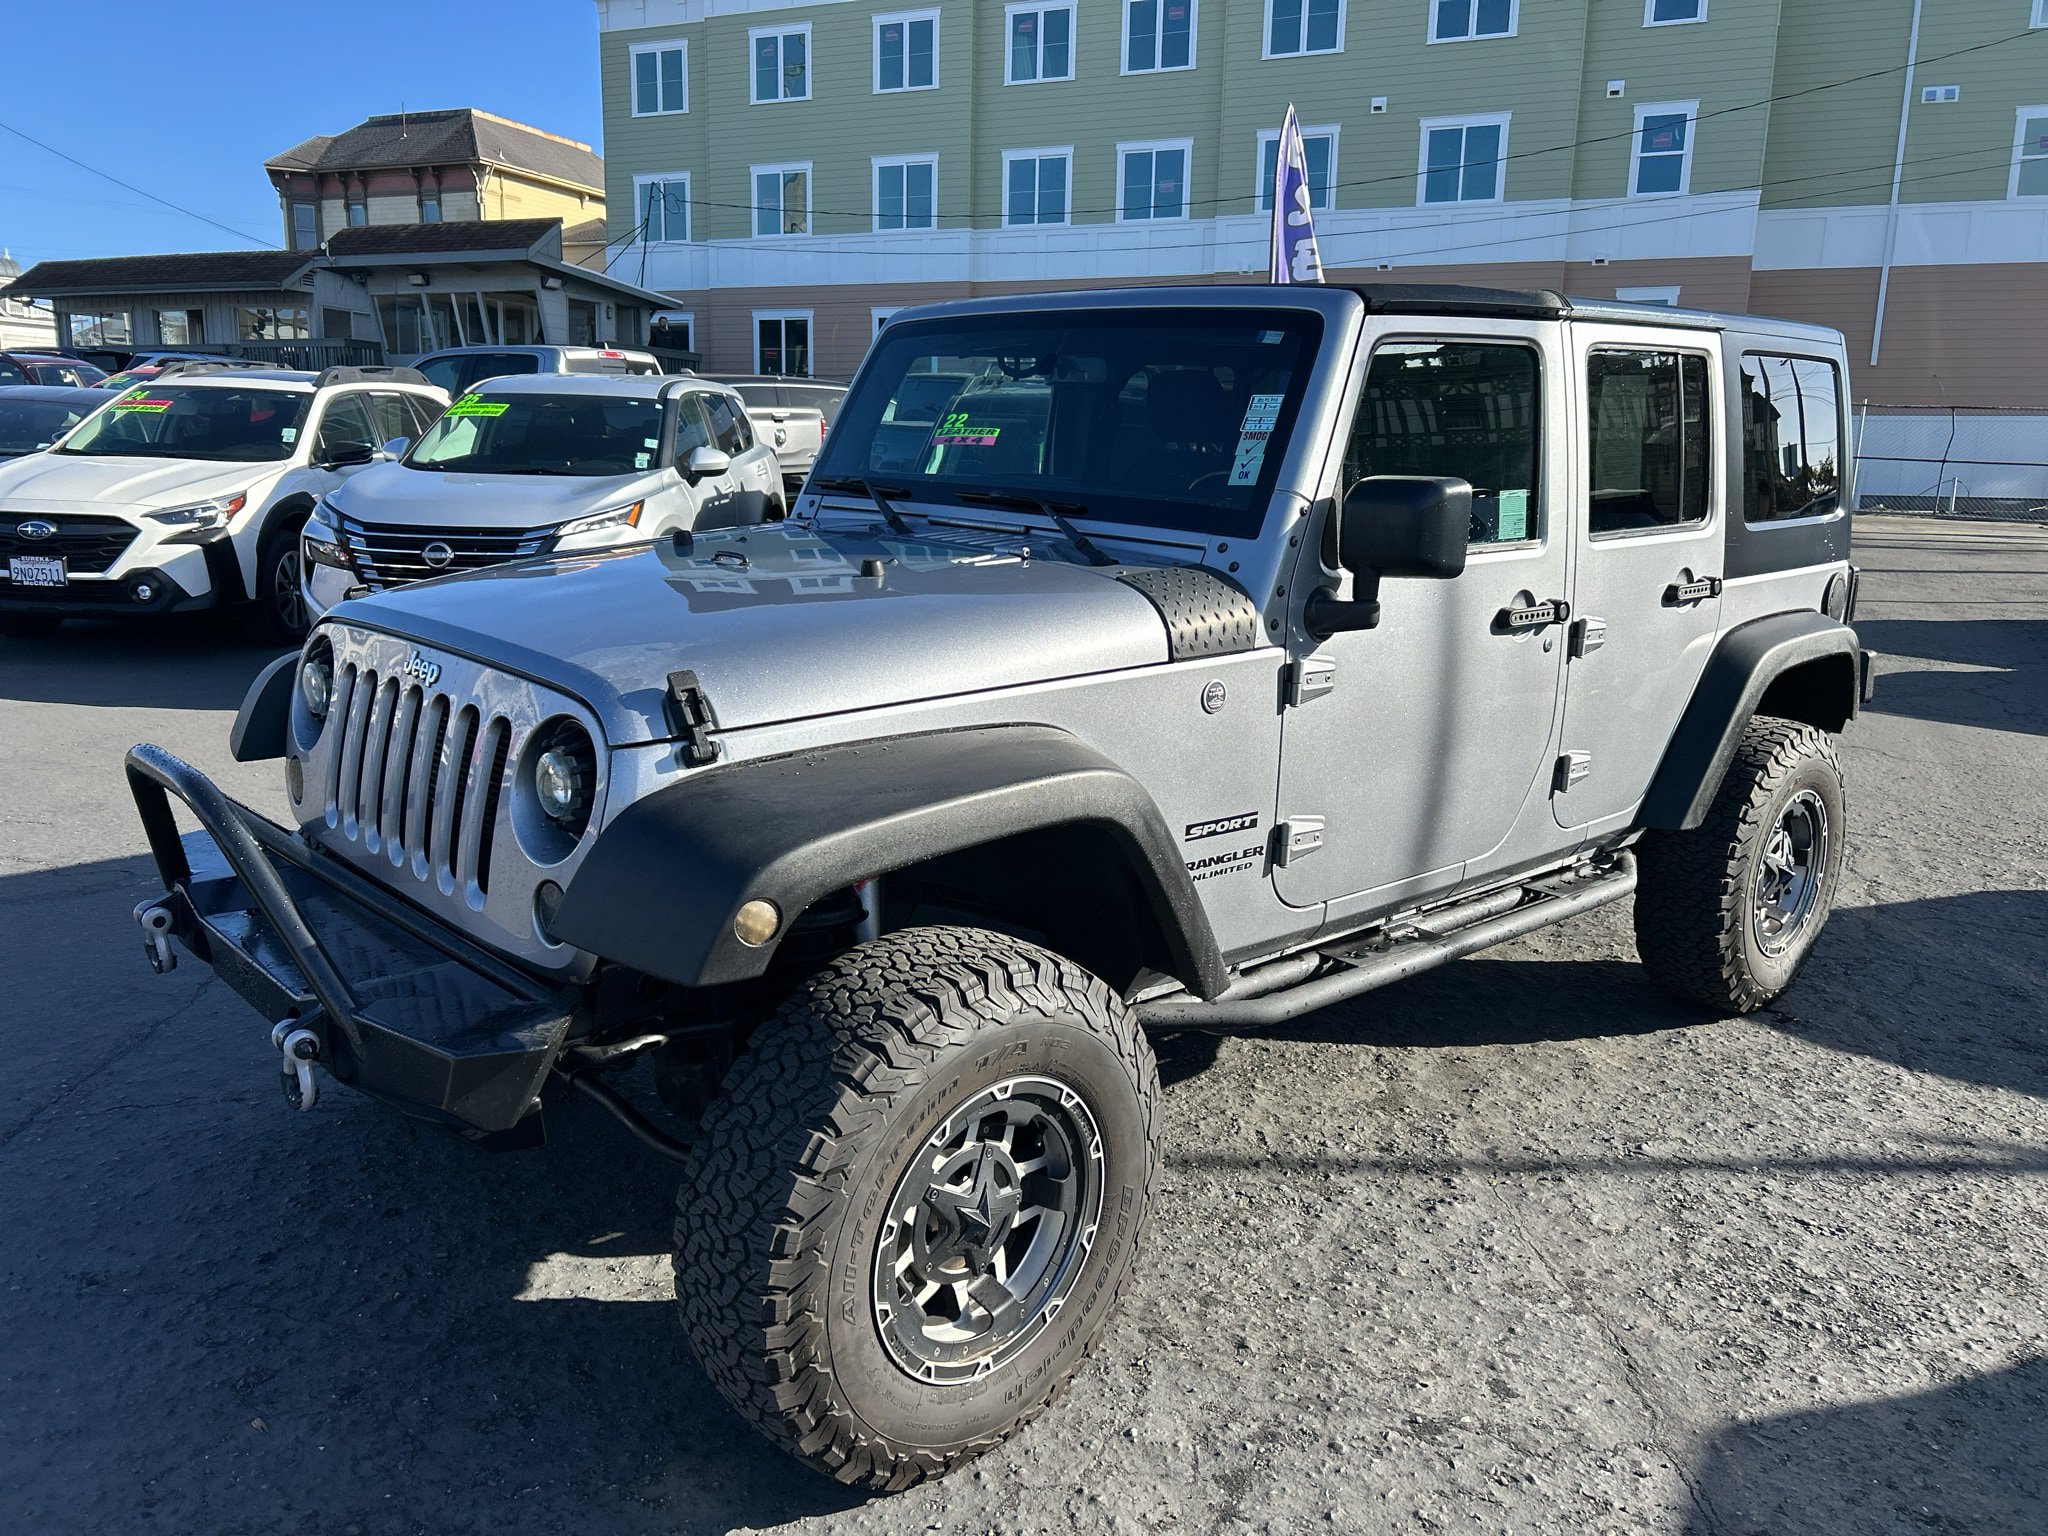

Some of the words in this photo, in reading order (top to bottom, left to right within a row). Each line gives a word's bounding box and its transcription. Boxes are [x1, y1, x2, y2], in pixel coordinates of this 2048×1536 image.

[457, 394, 484, 404] 25
[943, 413, 969, 428] 22
[1243, 432, 1268, 441] SMOG
[1238, 471, 1250, 480] OK
[404, 650, 440, 687] Jeep
[1185, 815, 1258, 839] SPORT
[1185, 846, 1264, 871] RANGLER
[1192, 862, 1253, 881] NLIMITED
[975, 1040, 1029, 1072] T/A
[1004, 1184, 1135, 1404] BFGoodrich
